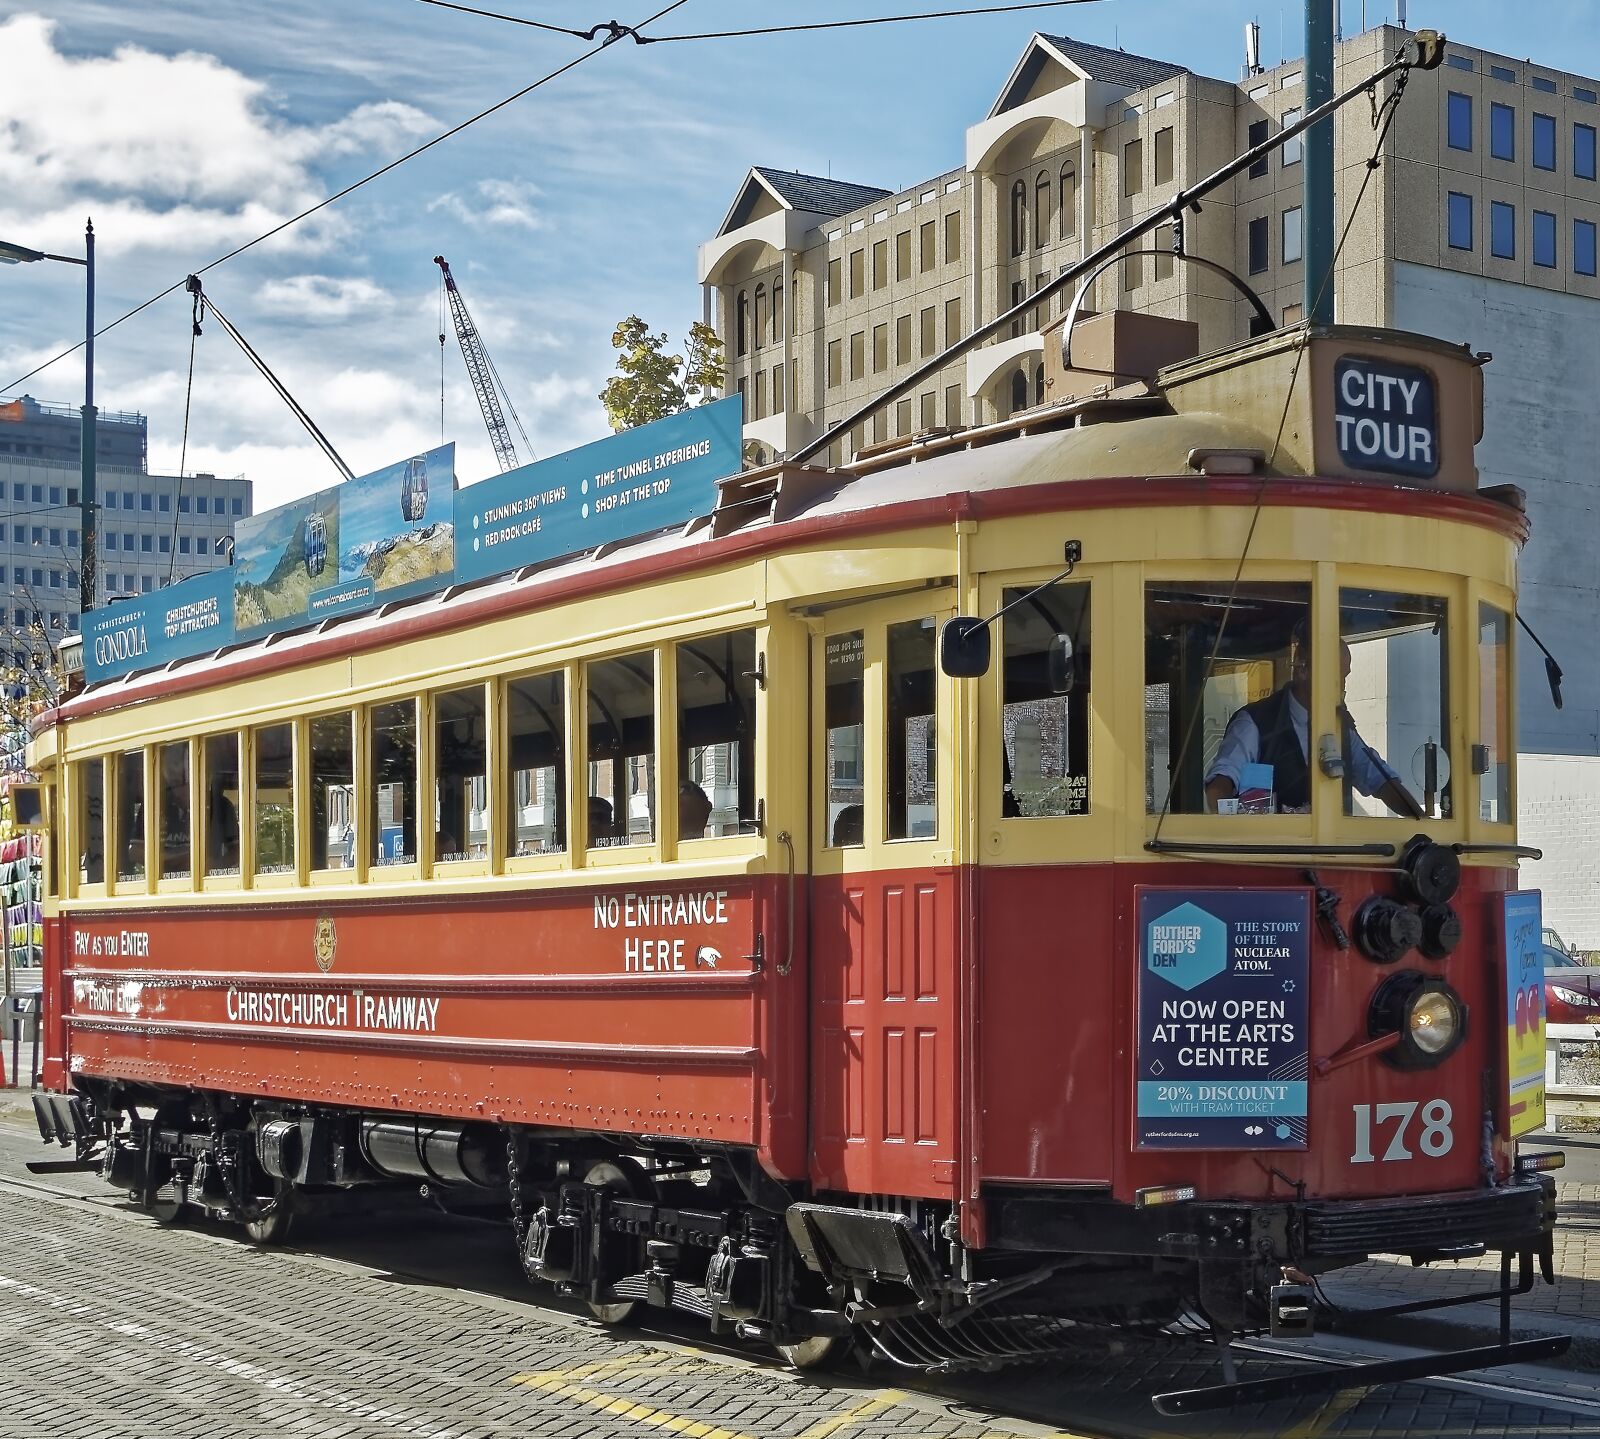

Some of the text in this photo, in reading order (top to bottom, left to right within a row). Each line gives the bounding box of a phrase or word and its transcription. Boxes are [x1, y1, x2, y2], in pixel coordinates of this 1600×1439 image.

[1341, 369, 1420, 415] CITY
[1335, 414, 1432, 463] TOUR
[595, 439, 710, 489] TIME TUNNEL EXPERIENCE
[484, 500, 523, 525] STUNNING
[541, 486, 566, 507] VIEWS
[595, 478, 671, 514] SHOP AT THE TOP
[485, 515, 541, 548] RED ROCK CAFÉ
[98, 612, 141, 630] CHRISTCHURCH
[166, 596, 218, 623] CHRISTCHURCH'S
[180, 612, 220, 635] ATTRACTION
[95, 624, 148, 666] GONDOLA
[594, 891, 728, 929] NO ENTRANCE
[1153, 926, 1201, 940] RUTHER
[1235, 922, 1301, 932] THE STORY
[74, 930, 149, 957] PAY AS YOU ENTER
[1153, 939, 1196, 954] FORD'S
[1234, 935, 1277, 945] OF THE
[625, 938, 686, 972] HERE
[1153, 954, 1177, 967] DEN
[1234, 947, 1291, 958] NUCLEAR
[1234, 960, 1272, 971] ATOM.
[89, 987, 114, 1011] FRONT
[226, 985, 440, 1032] CHRISTCHURCH TRAMWAY
[1162, 1000, 1285, 1019] NOW OPEN
[1151, 1023, 1295, 1043] AT THE ARTS
[1177, 1047, 1270, 1066] CENTRE
[1157, 1086, 1288, 1101] 20% DISCOUNT
[1170, 1102, 1275, 1113] WITH TRAM TICKET
[1350, 1098, 1454, 1163] 178
